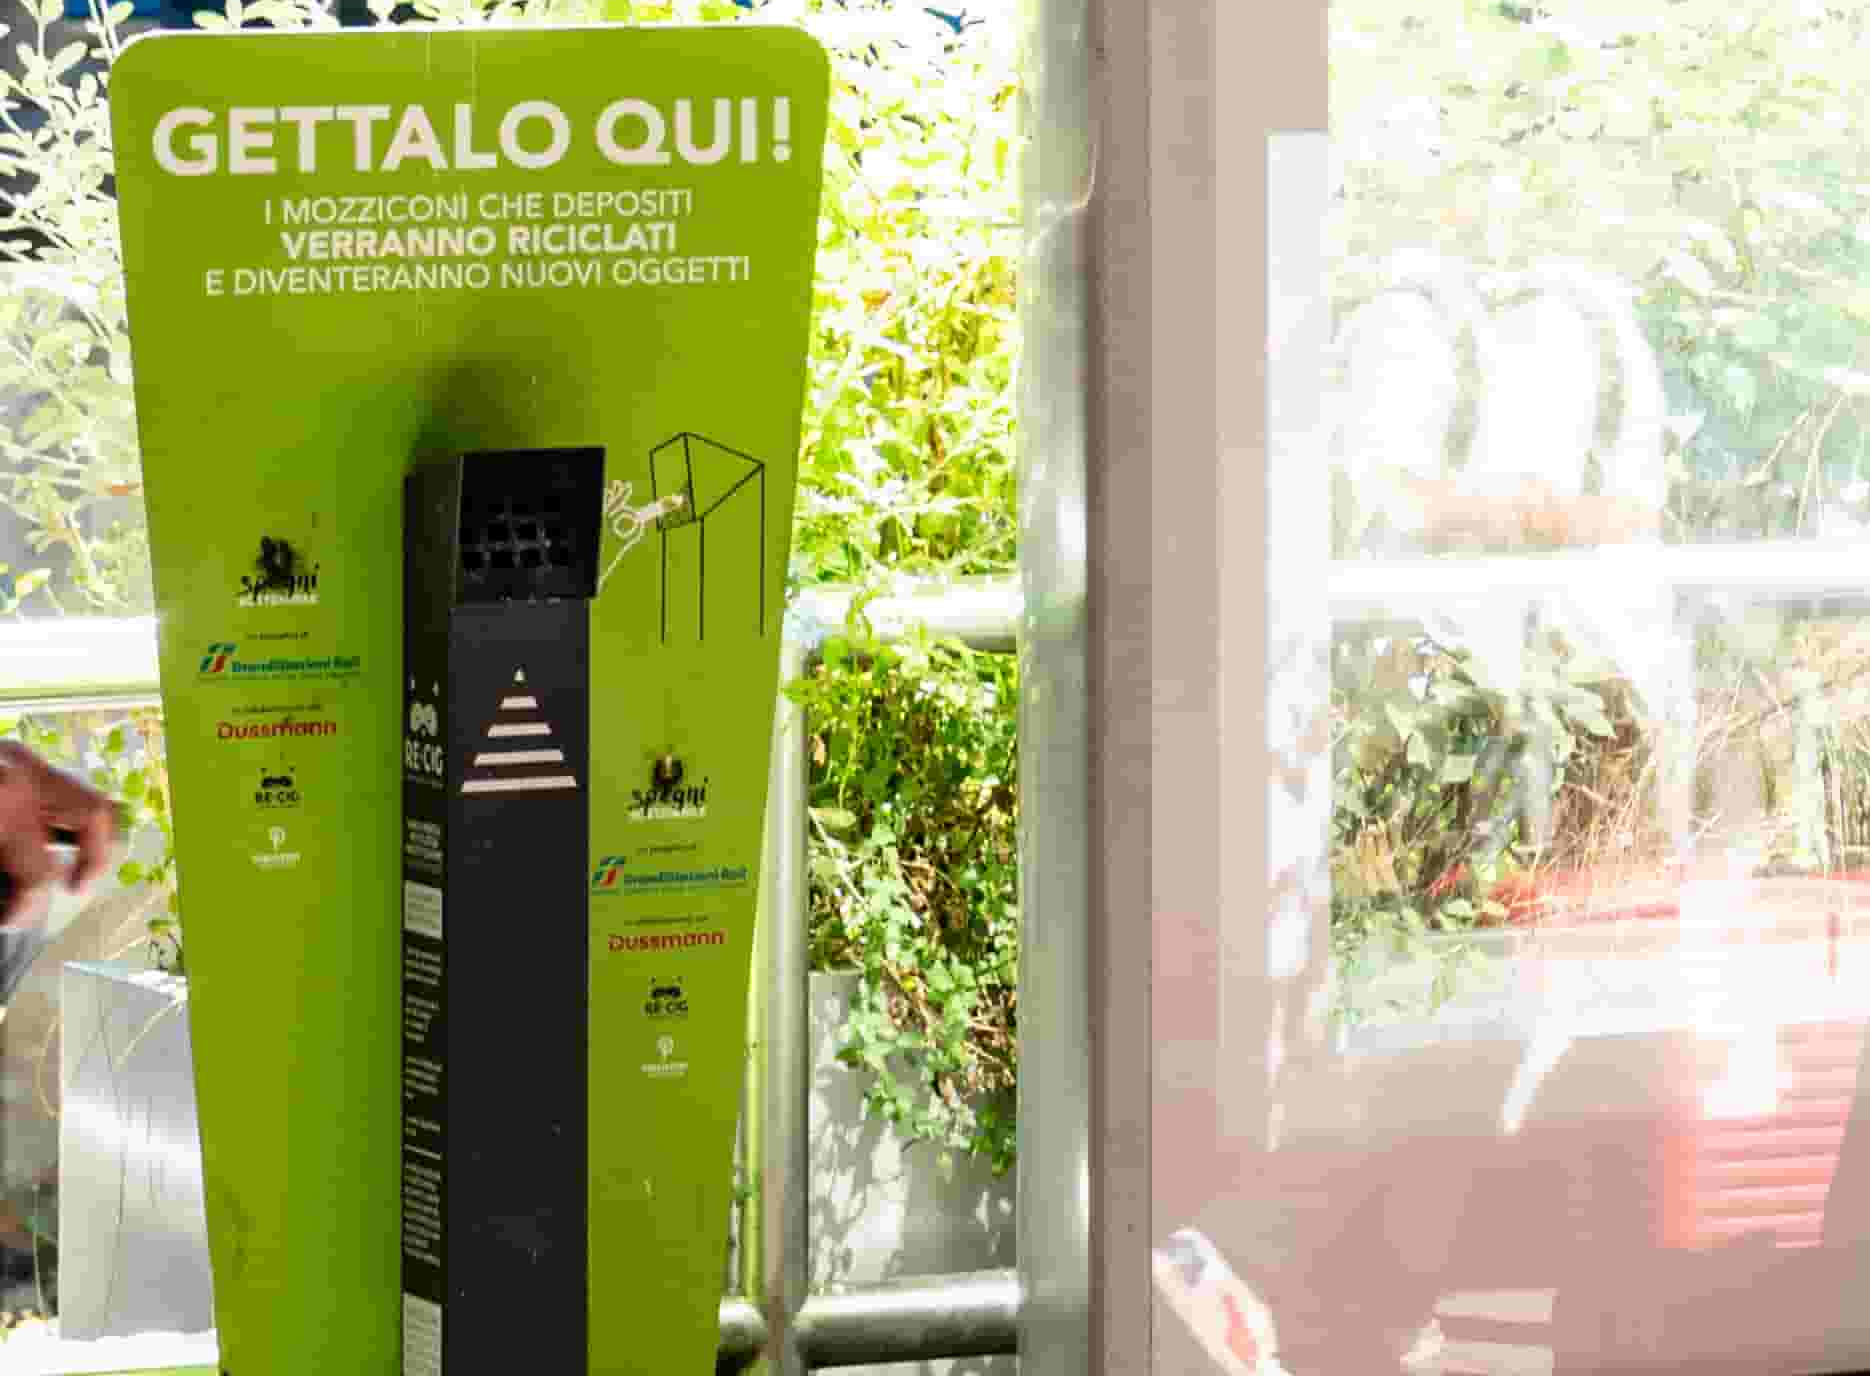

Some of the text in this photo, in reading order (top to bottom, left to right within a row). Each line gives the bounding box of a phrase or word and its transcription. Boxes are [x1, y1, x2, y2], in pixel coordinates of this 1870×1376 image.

[152, 96, 792, 176] GETTALO QUI!
[264, 189, 692, 224] I MOZZICONI CHE DEPOSITI
[280, 221, 676, 259] VERRANNO RICICLATI
[205, 256, 749, 296] E DIVENTERANNO NUOVI OGGETTI
[216, 720, 336, 739] Dussmann
[608, 930, 726, 952] Dussmann
